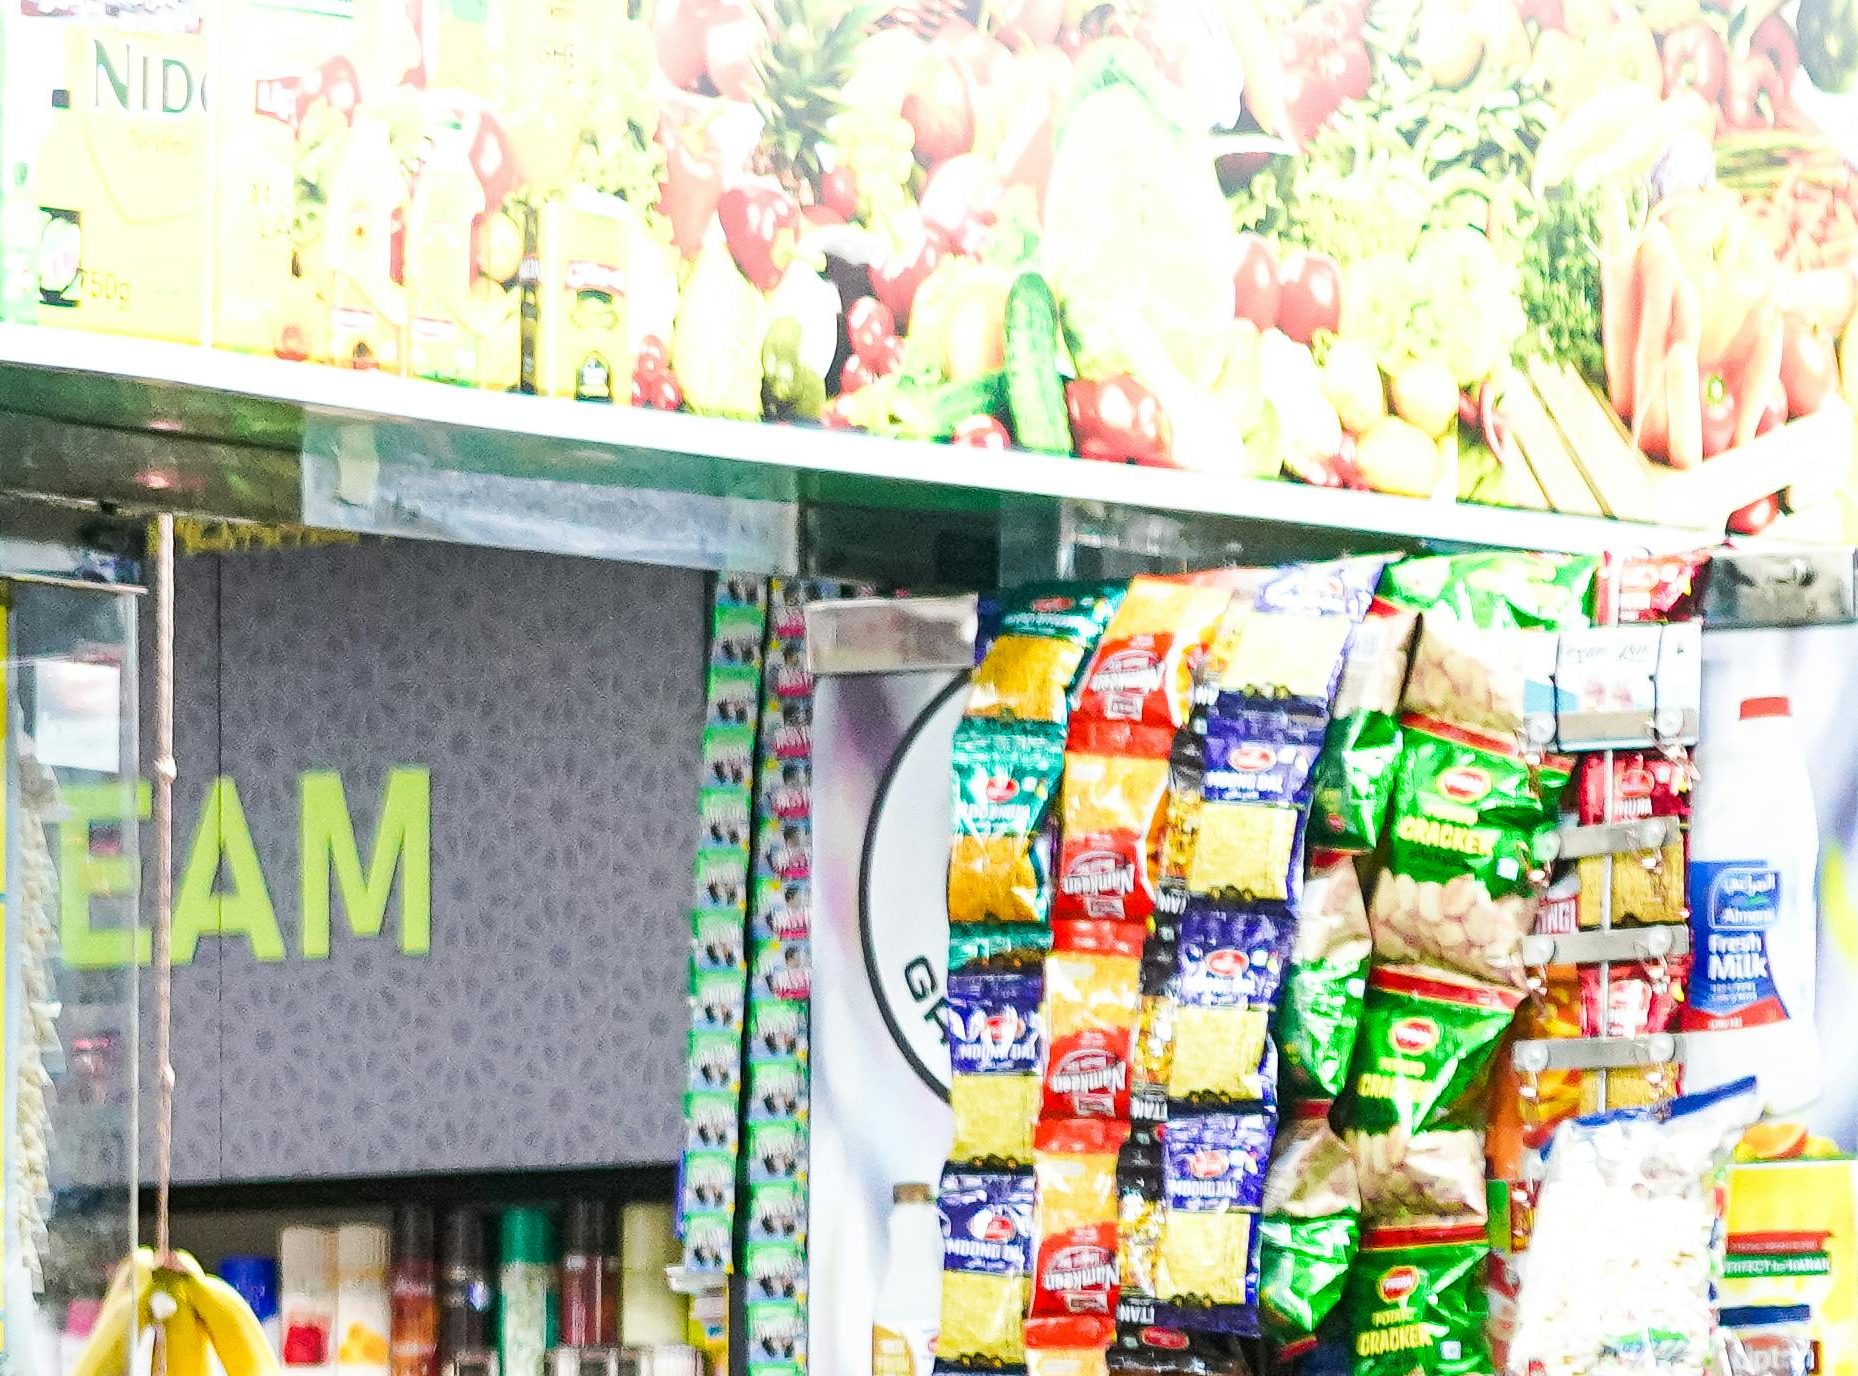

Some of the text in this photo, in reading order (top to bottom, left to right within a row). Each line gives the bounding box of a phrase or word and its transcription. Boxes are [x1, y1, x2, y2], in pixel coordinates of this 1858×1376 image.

[1709, 932, 1763, 954] Fresh
[1708, 950, 1768, 982] Milk
[1357, 1323, 1434, 1356] CRACKER
